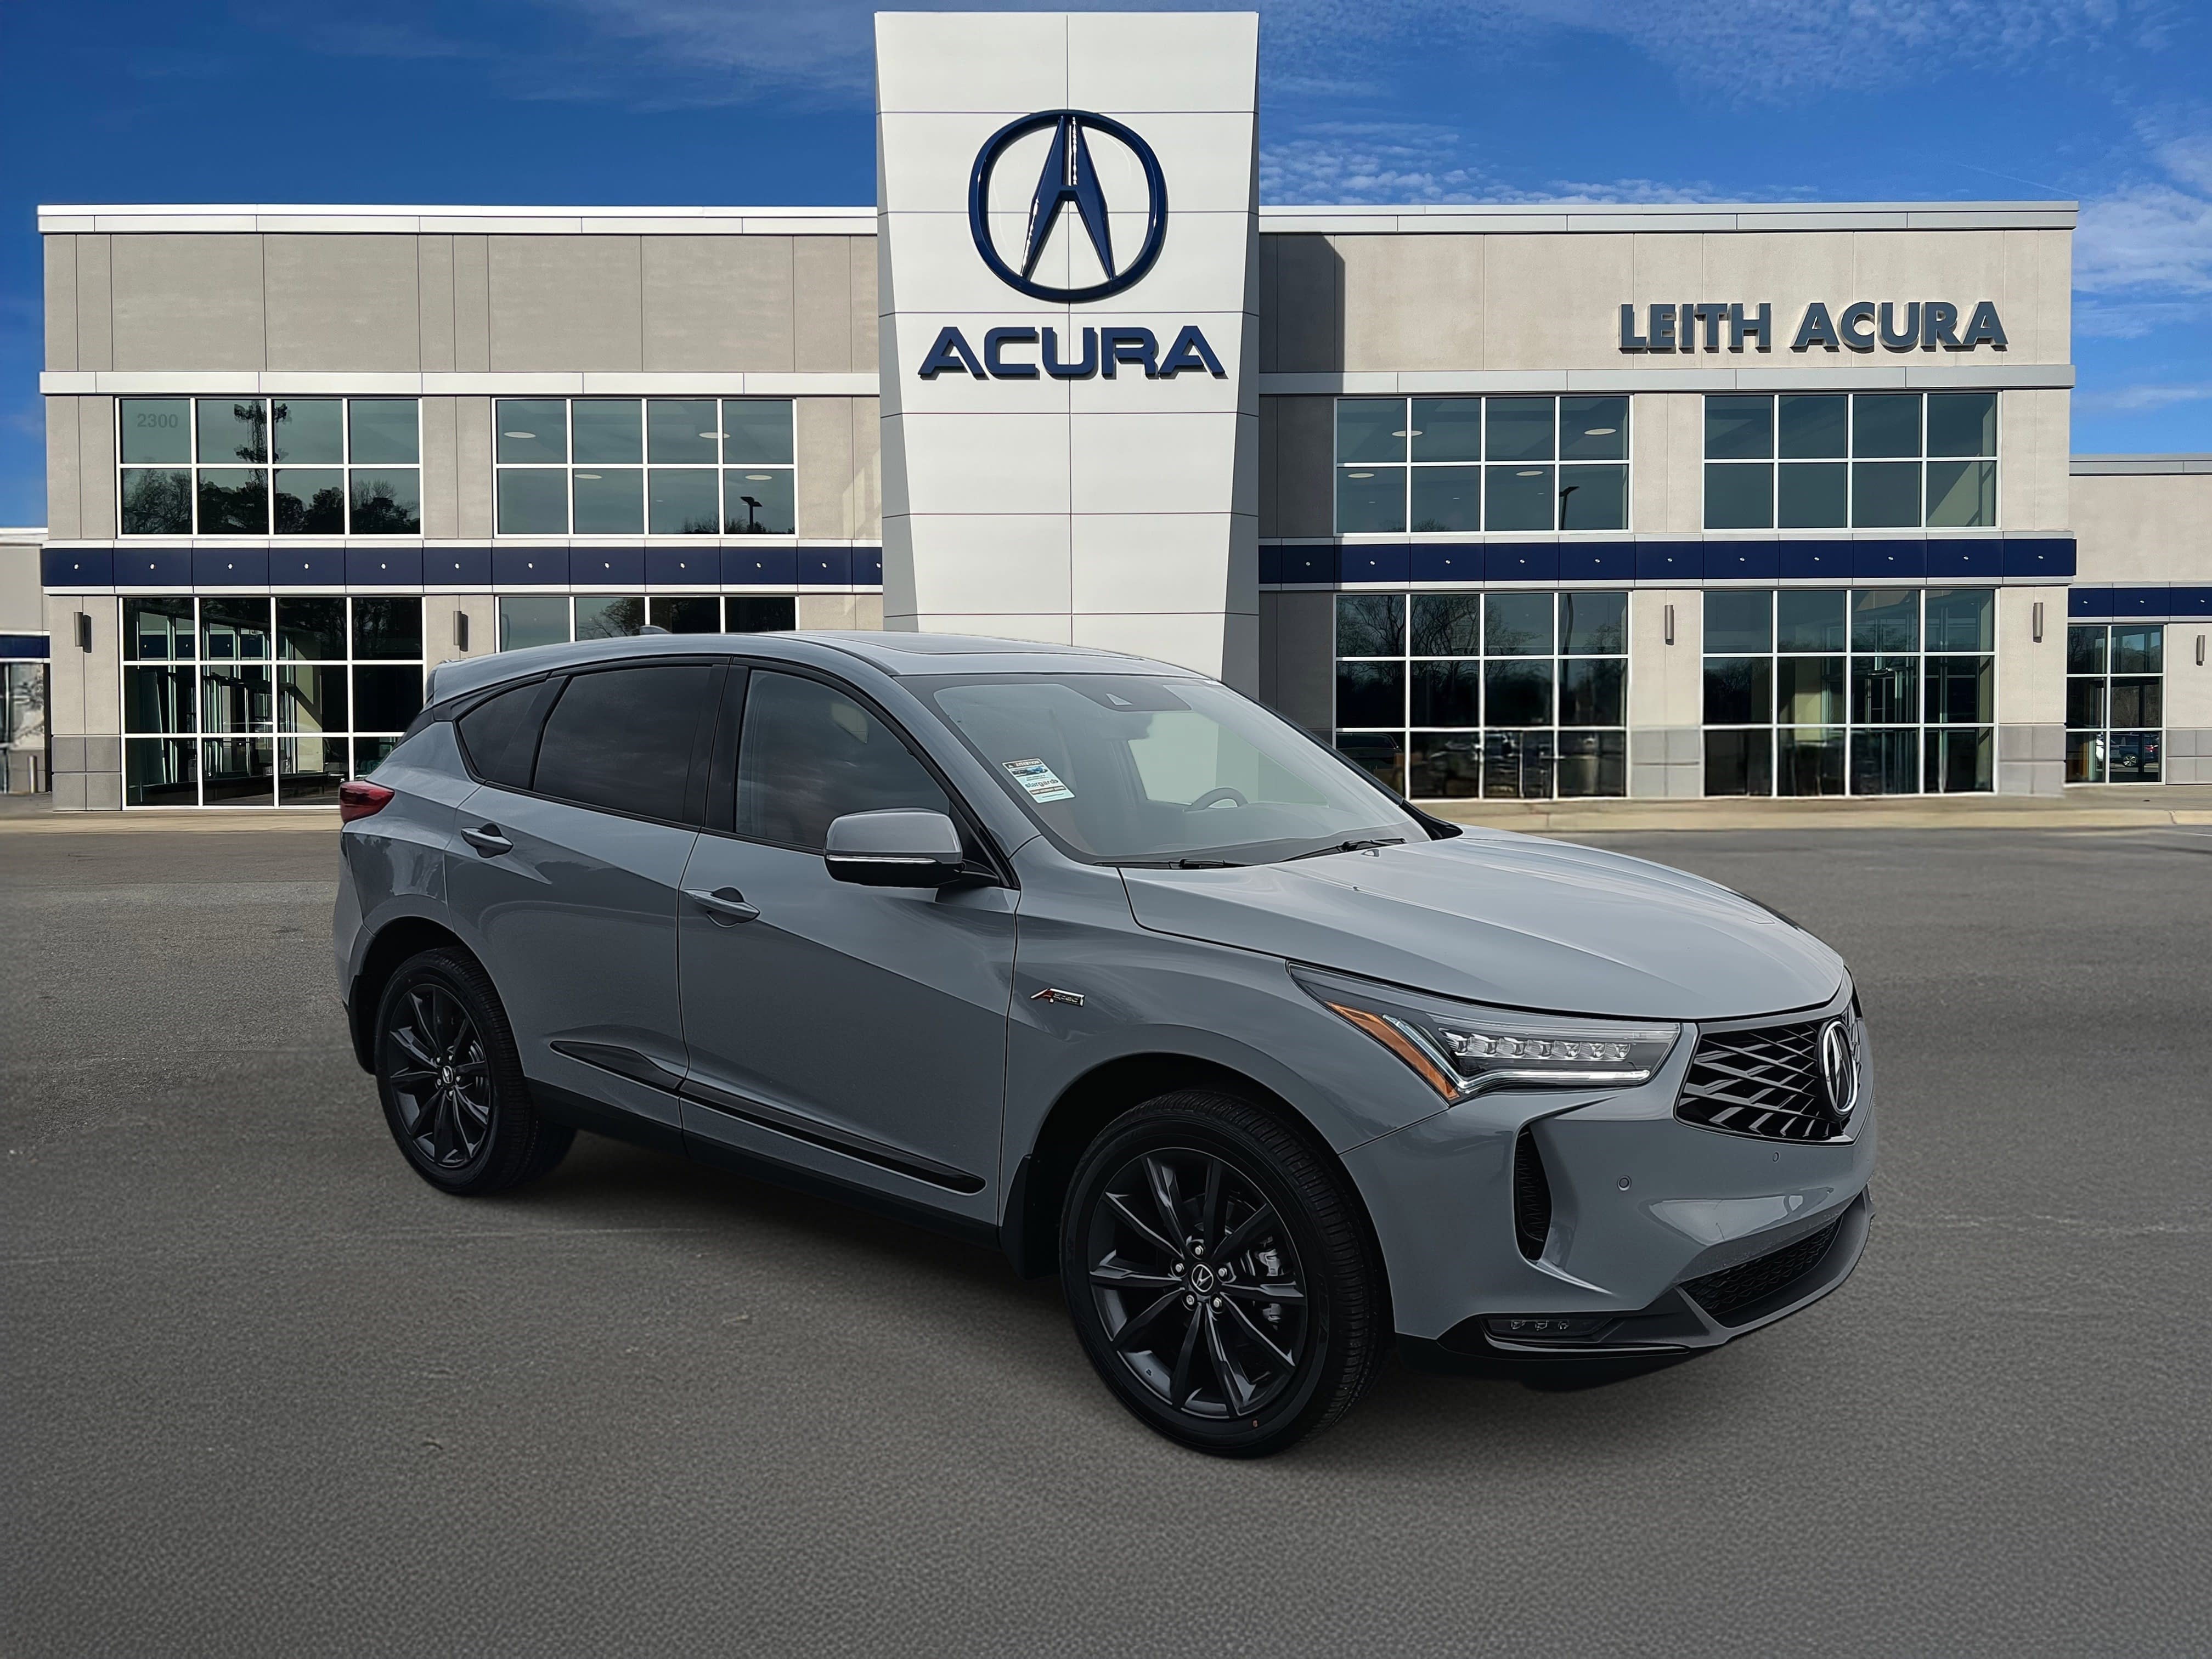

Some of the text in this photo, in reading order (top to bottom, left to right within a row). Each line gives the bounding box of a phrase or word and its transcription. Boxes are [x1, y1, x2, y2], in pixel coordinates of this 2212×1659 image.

[918, 325, 1227, 378] ACURA
[1618, 301, 2008, 353] LEITH ACURA
[138, 413, 178, 428] 2300
